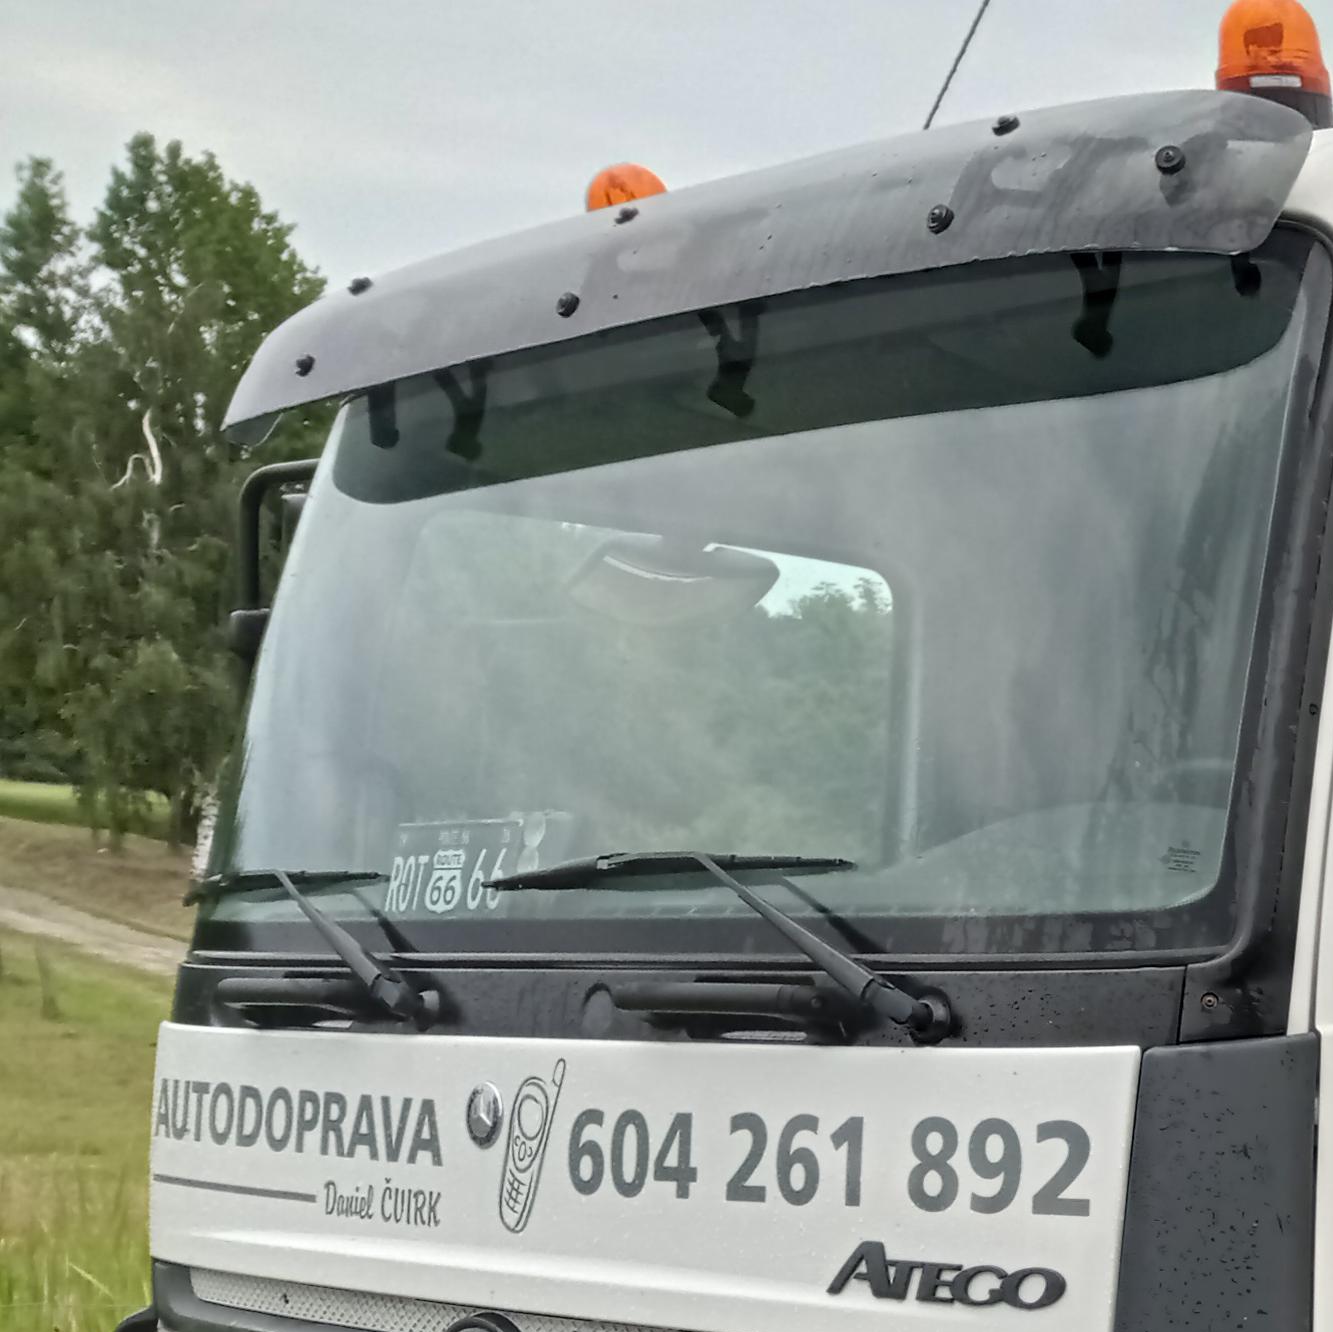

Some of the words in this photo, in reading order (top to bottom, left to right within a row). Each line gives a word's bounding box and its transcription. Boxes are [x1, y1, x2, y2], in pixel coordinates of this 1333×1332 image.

[430, 874, 457, 906] 66
[154, 1078, 443, 1167] AUTODOPRAVA
[569, 1108, 698, 1200] 604
[726, 1111, 864, 1207] 261
[907, 1116, 1091, 1217] 892
[324, 1179, 374, 1220] Daniel
[826, 1240, 1068, 1312] ATEGO
